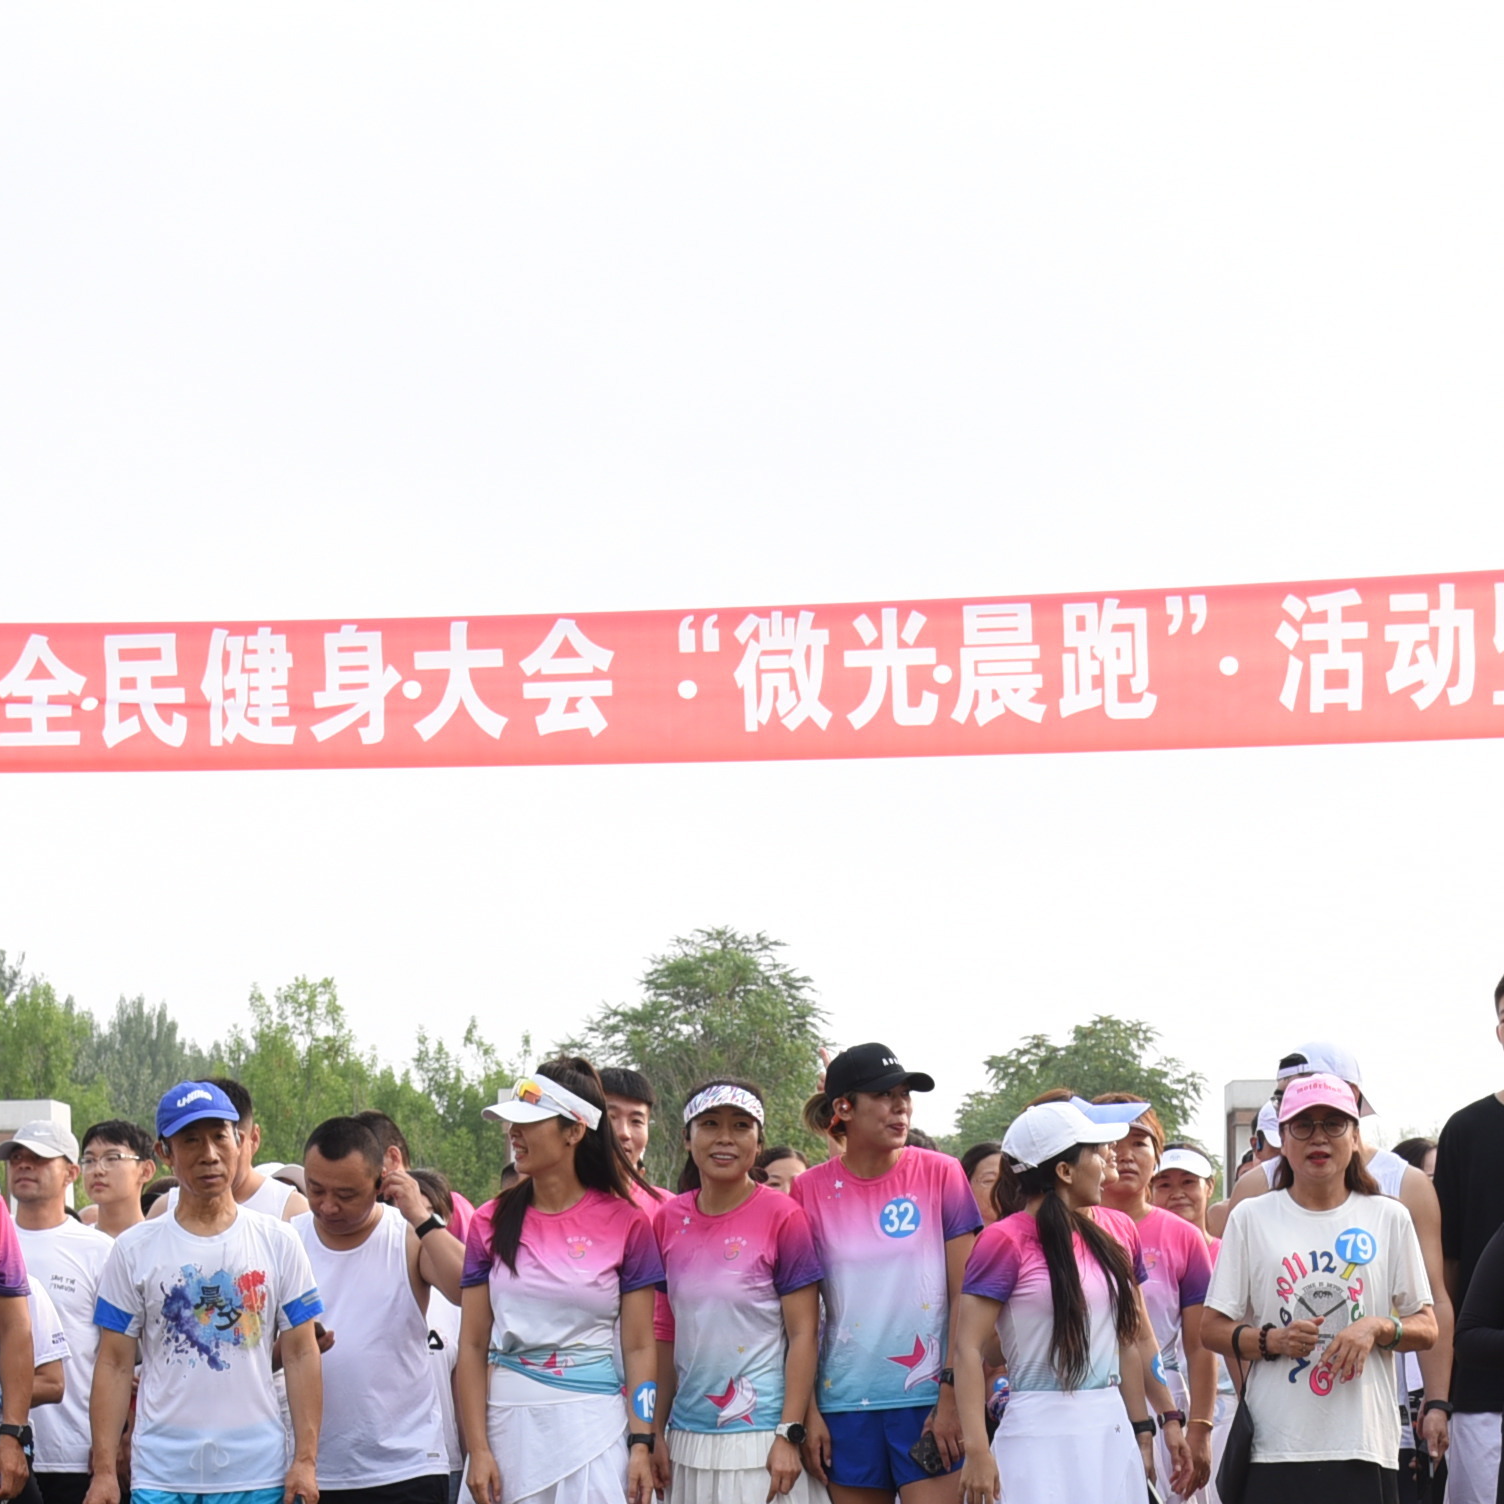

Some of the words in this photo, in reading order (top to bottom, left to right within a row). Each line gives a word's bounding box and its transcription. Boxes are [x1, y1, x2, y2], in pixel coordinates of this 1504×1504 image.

[884, 1202, 916, 1233] 32
[1339, 1233, 1373, 1260] 79
[1309, 1250, 1337, 1274] 12
